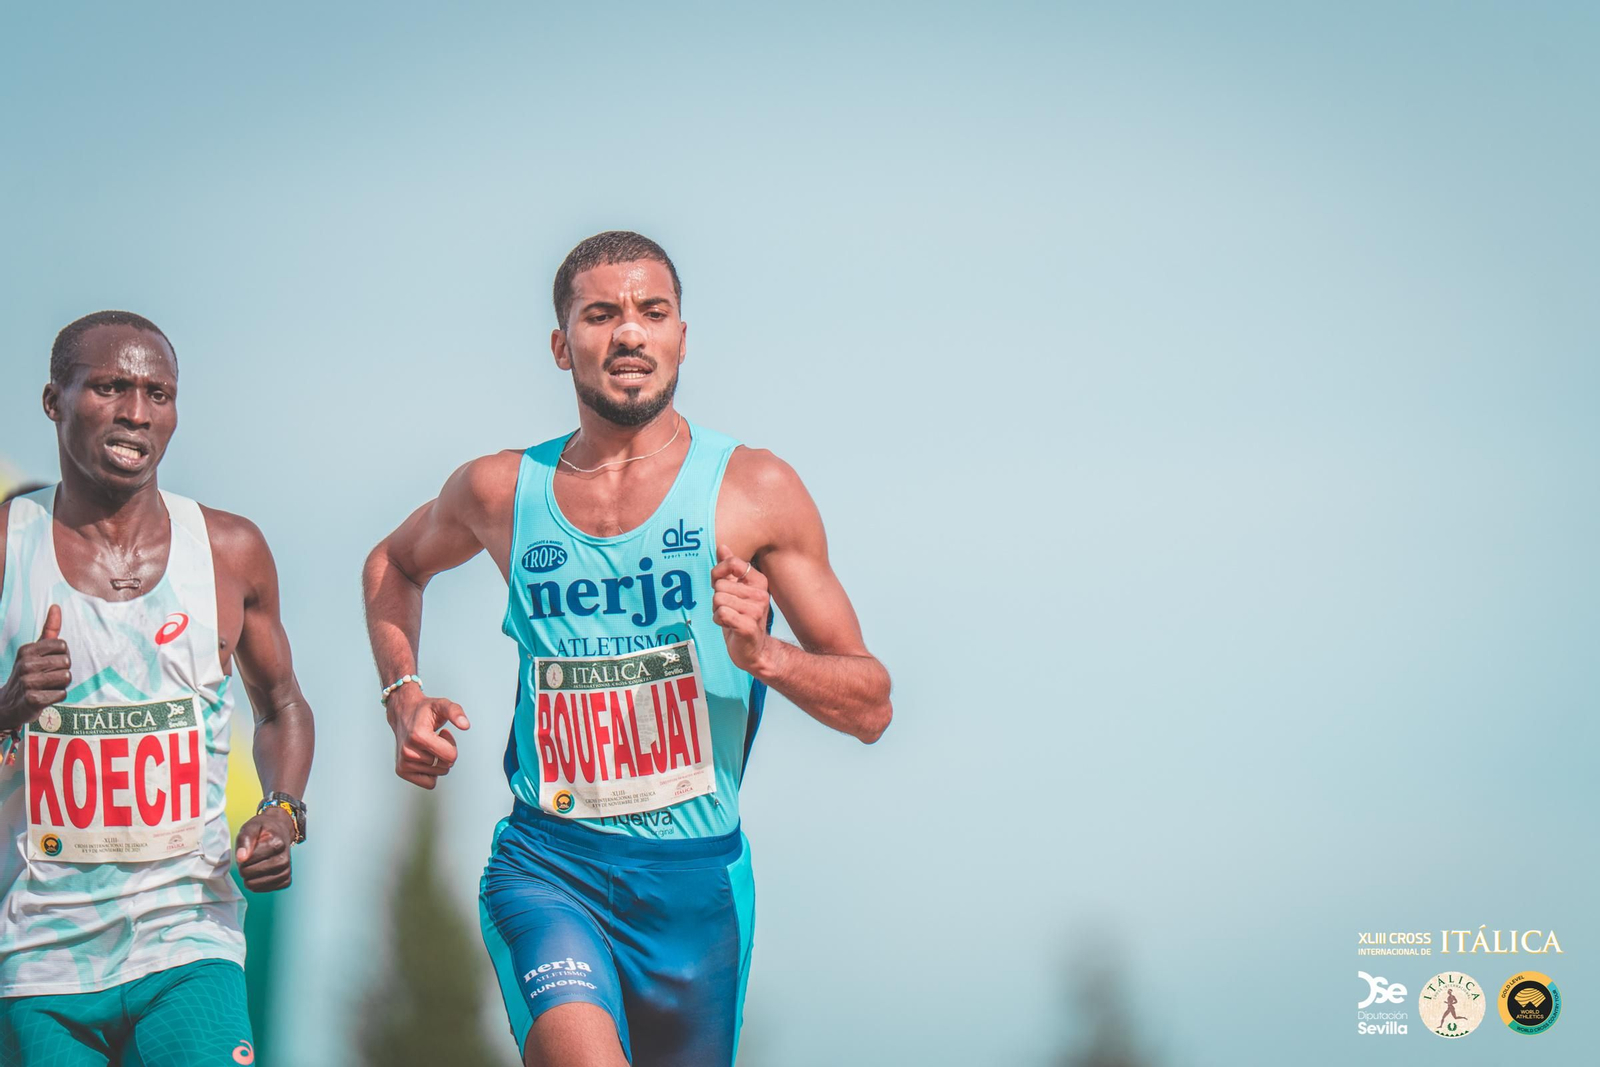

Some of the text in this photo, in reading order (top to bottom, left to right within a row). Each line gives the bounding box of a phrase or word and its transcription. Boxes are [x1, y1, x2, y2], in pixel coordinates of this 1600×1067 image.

[523, 546, 566, 568] TROPS
[526, 557, 697, 627] nerja
[556, 632, 681, 657] ATLETISMO
[572, 661, 652, 684] ITÁLICA
[73, 708, 157, 730] ITÁLICA
[538, 676, 702, 784] BOUFALJAT
[29, 730, 200, 829] KOECH
[523, 957, 592, 983] nerja
[535, 970, 587, 984] ATLETISMO
